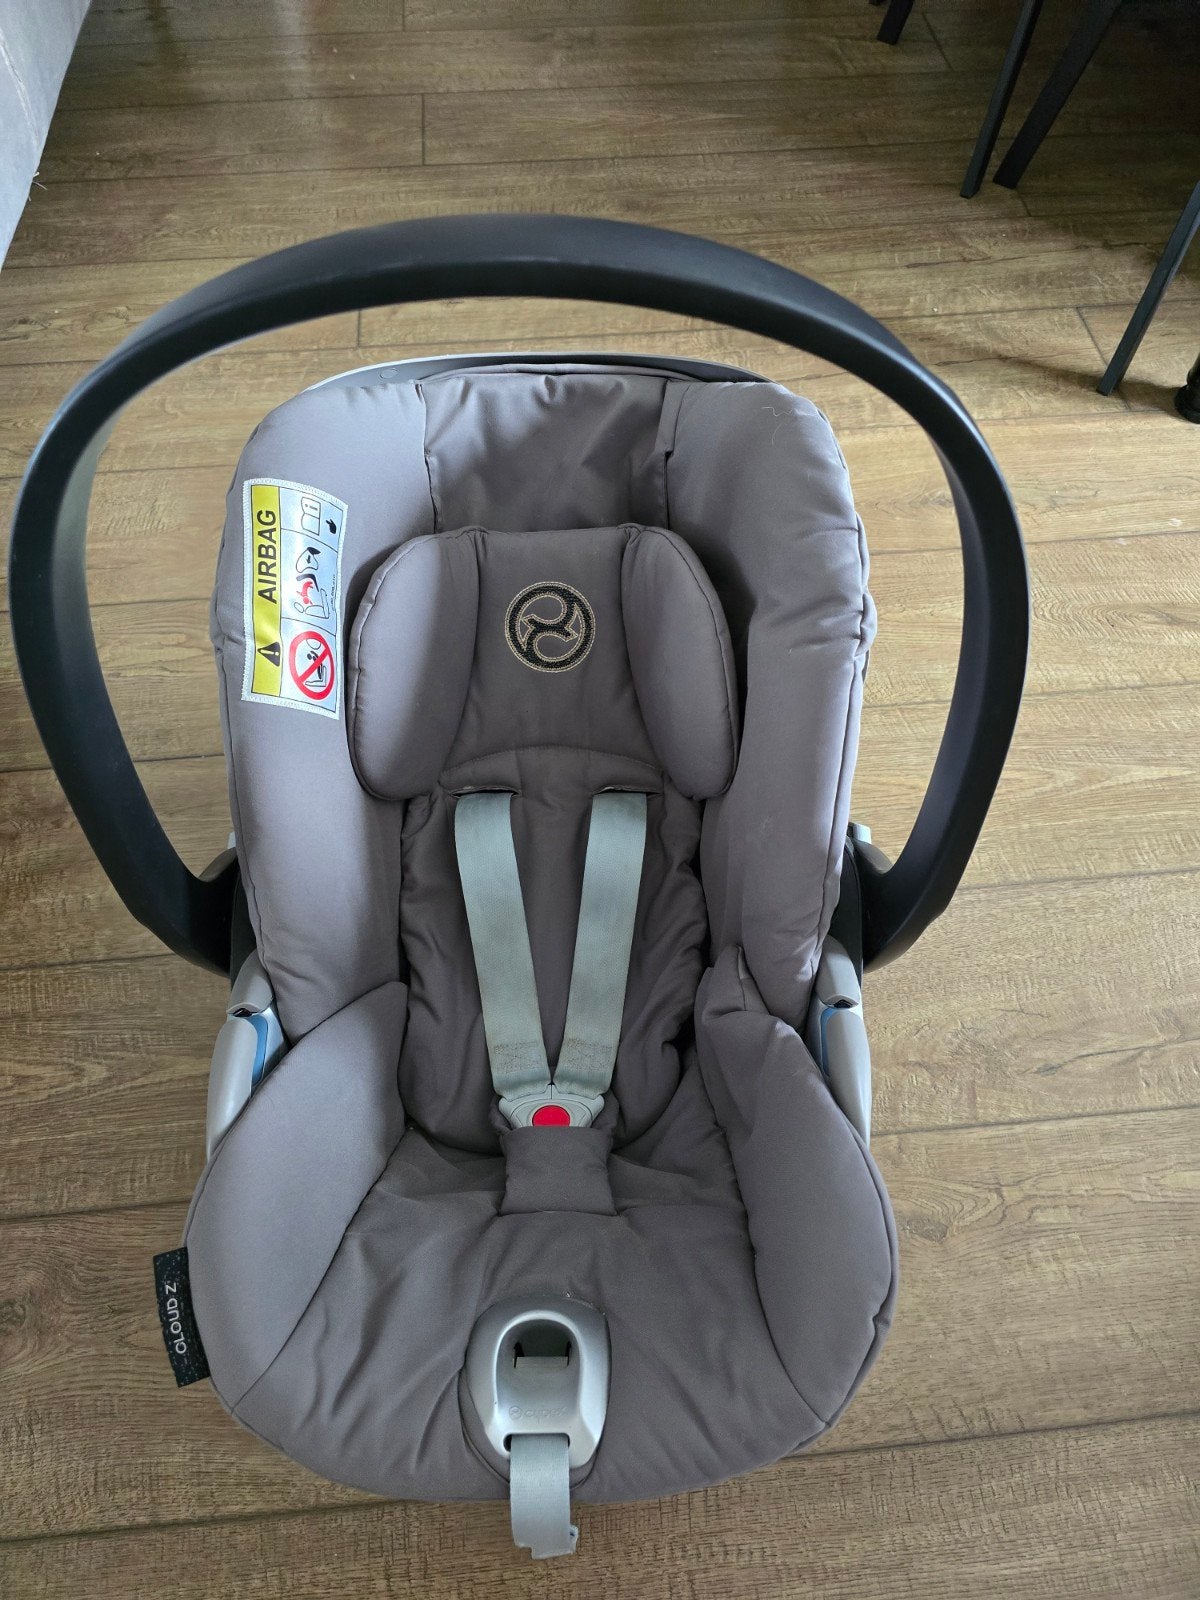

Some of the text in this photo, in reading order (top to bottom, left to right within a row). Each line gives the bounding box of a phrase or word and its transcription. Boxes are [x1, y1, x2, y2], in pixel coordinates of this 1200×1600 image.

[256, 509, 277, 605] AIRBAG
[165, 1282, 187, 1354] CLOUD Z
